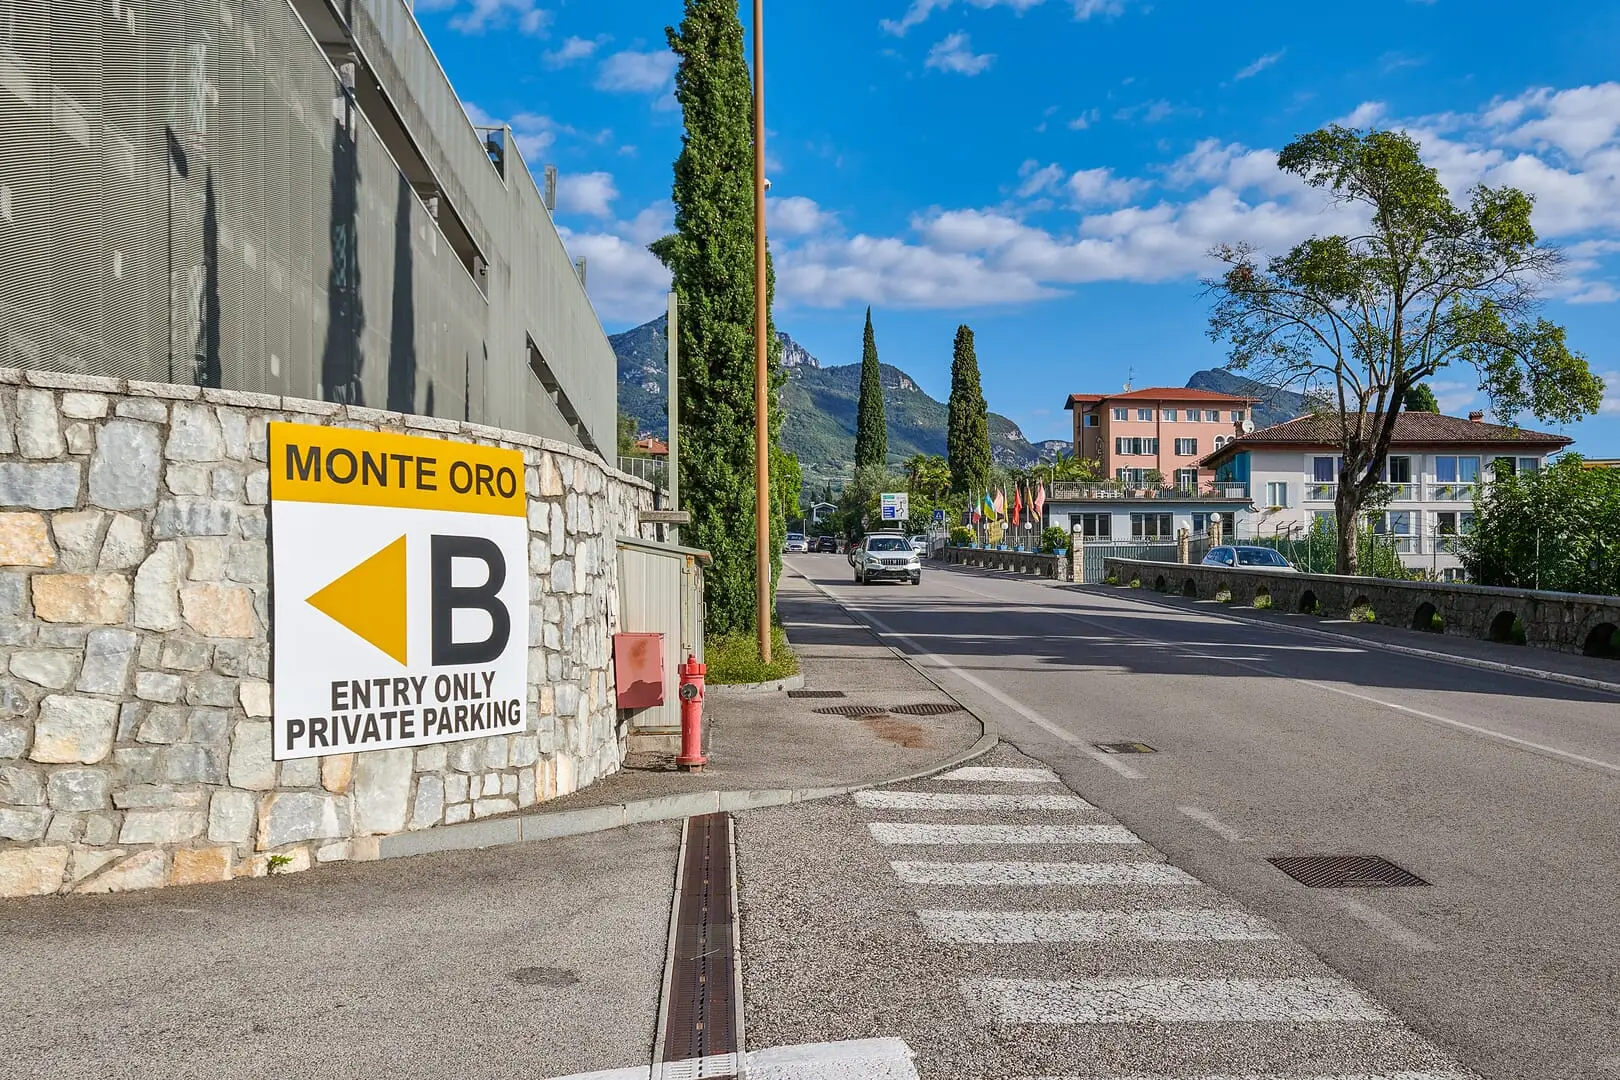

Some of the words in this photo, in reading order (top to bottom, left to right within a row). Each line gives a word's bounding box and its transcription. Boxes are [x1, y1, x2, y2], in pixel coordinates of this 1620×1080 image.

[286, 443, 437, 491] MONTE
[449, 460, 517, 499] ORO
[431, 534, 511, 667] B
[332, 675, 428, 711] ENTRY
[434, 671, 496, 702] ONLY
[286, 709, 415, 750] PRIVATE
[423, 699, 521, 736] PARKING
